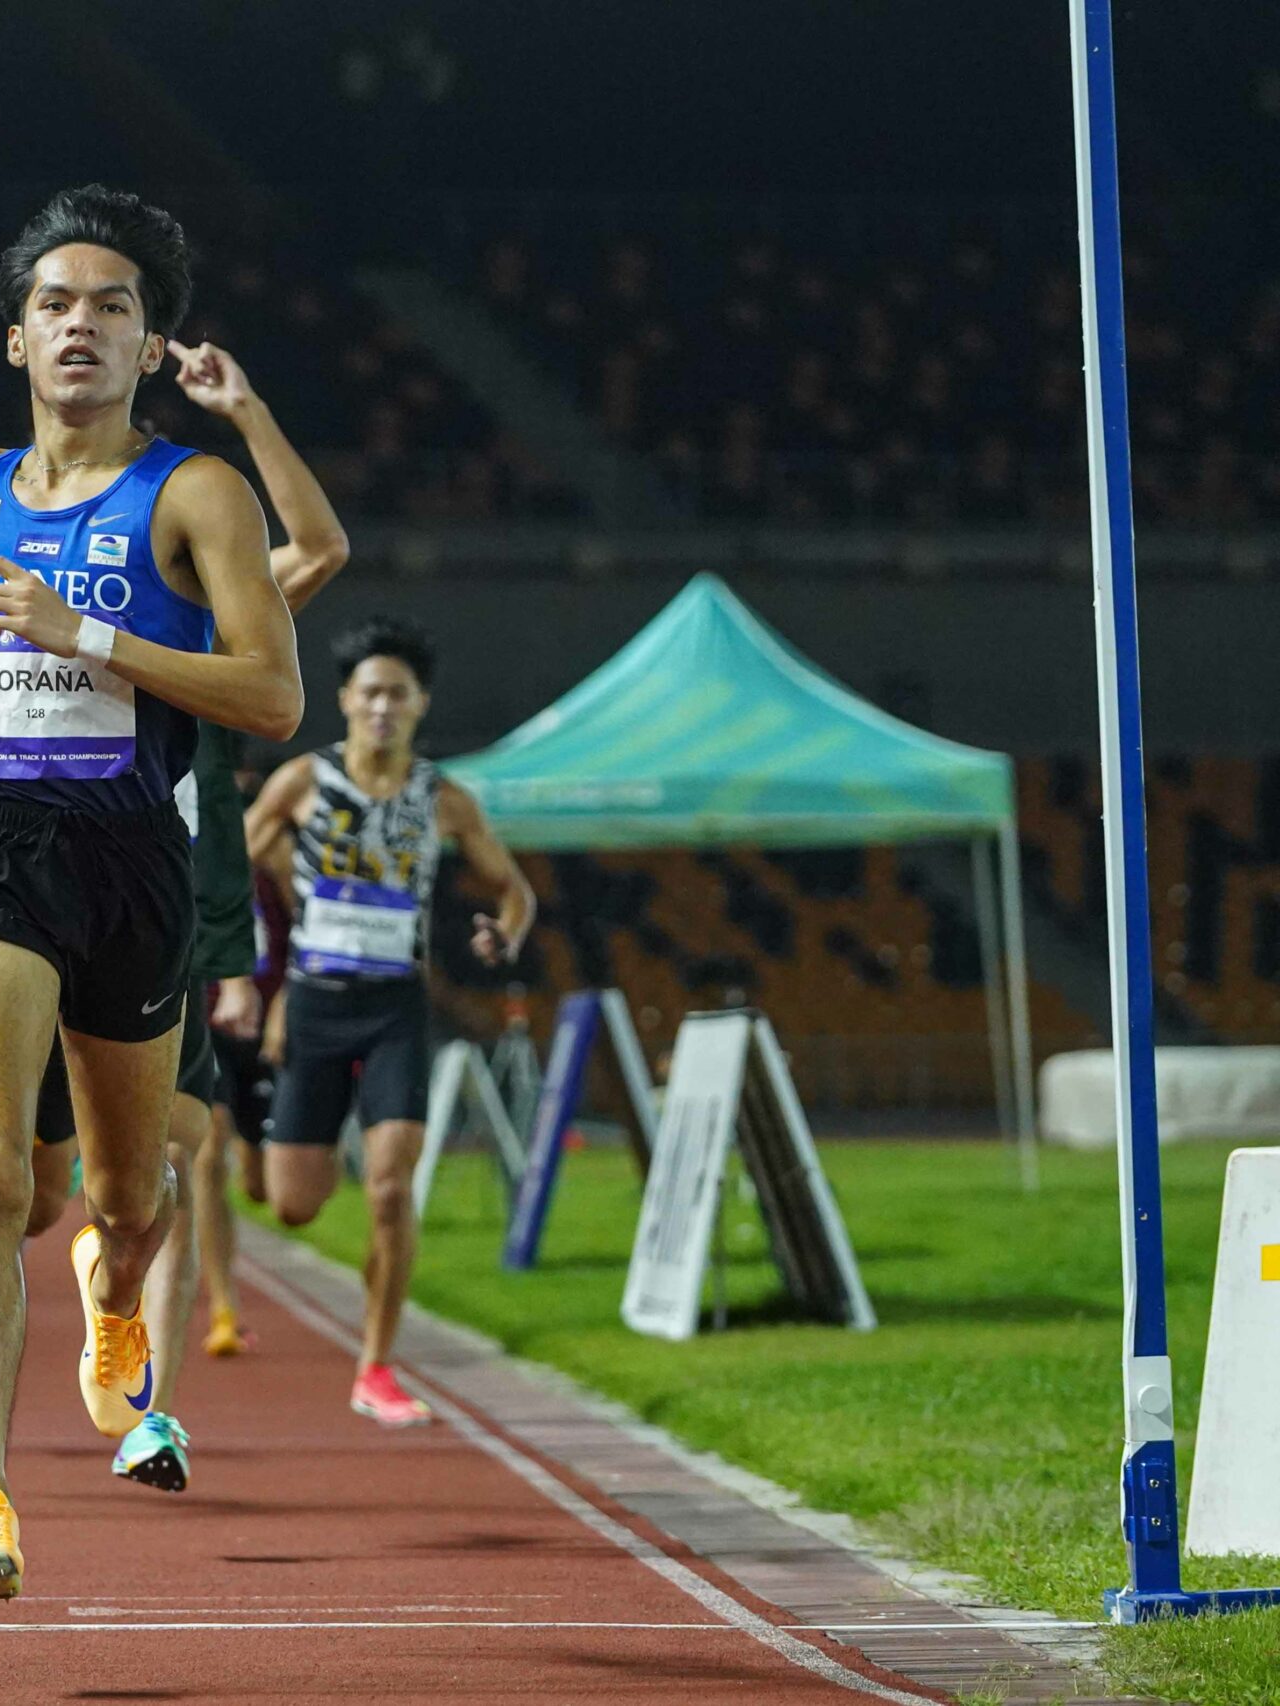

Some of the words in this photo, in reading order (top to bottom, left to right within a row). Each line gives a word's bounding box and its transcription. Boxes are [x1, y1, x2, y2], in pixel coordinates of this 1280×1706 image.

[25, 708, 46, 719] 128
[19, 753, 40, 761] TRACK
[48, 753, 67, 761] FIELD
[68, 752, 121, 760] CHAMPIONSHIPS
